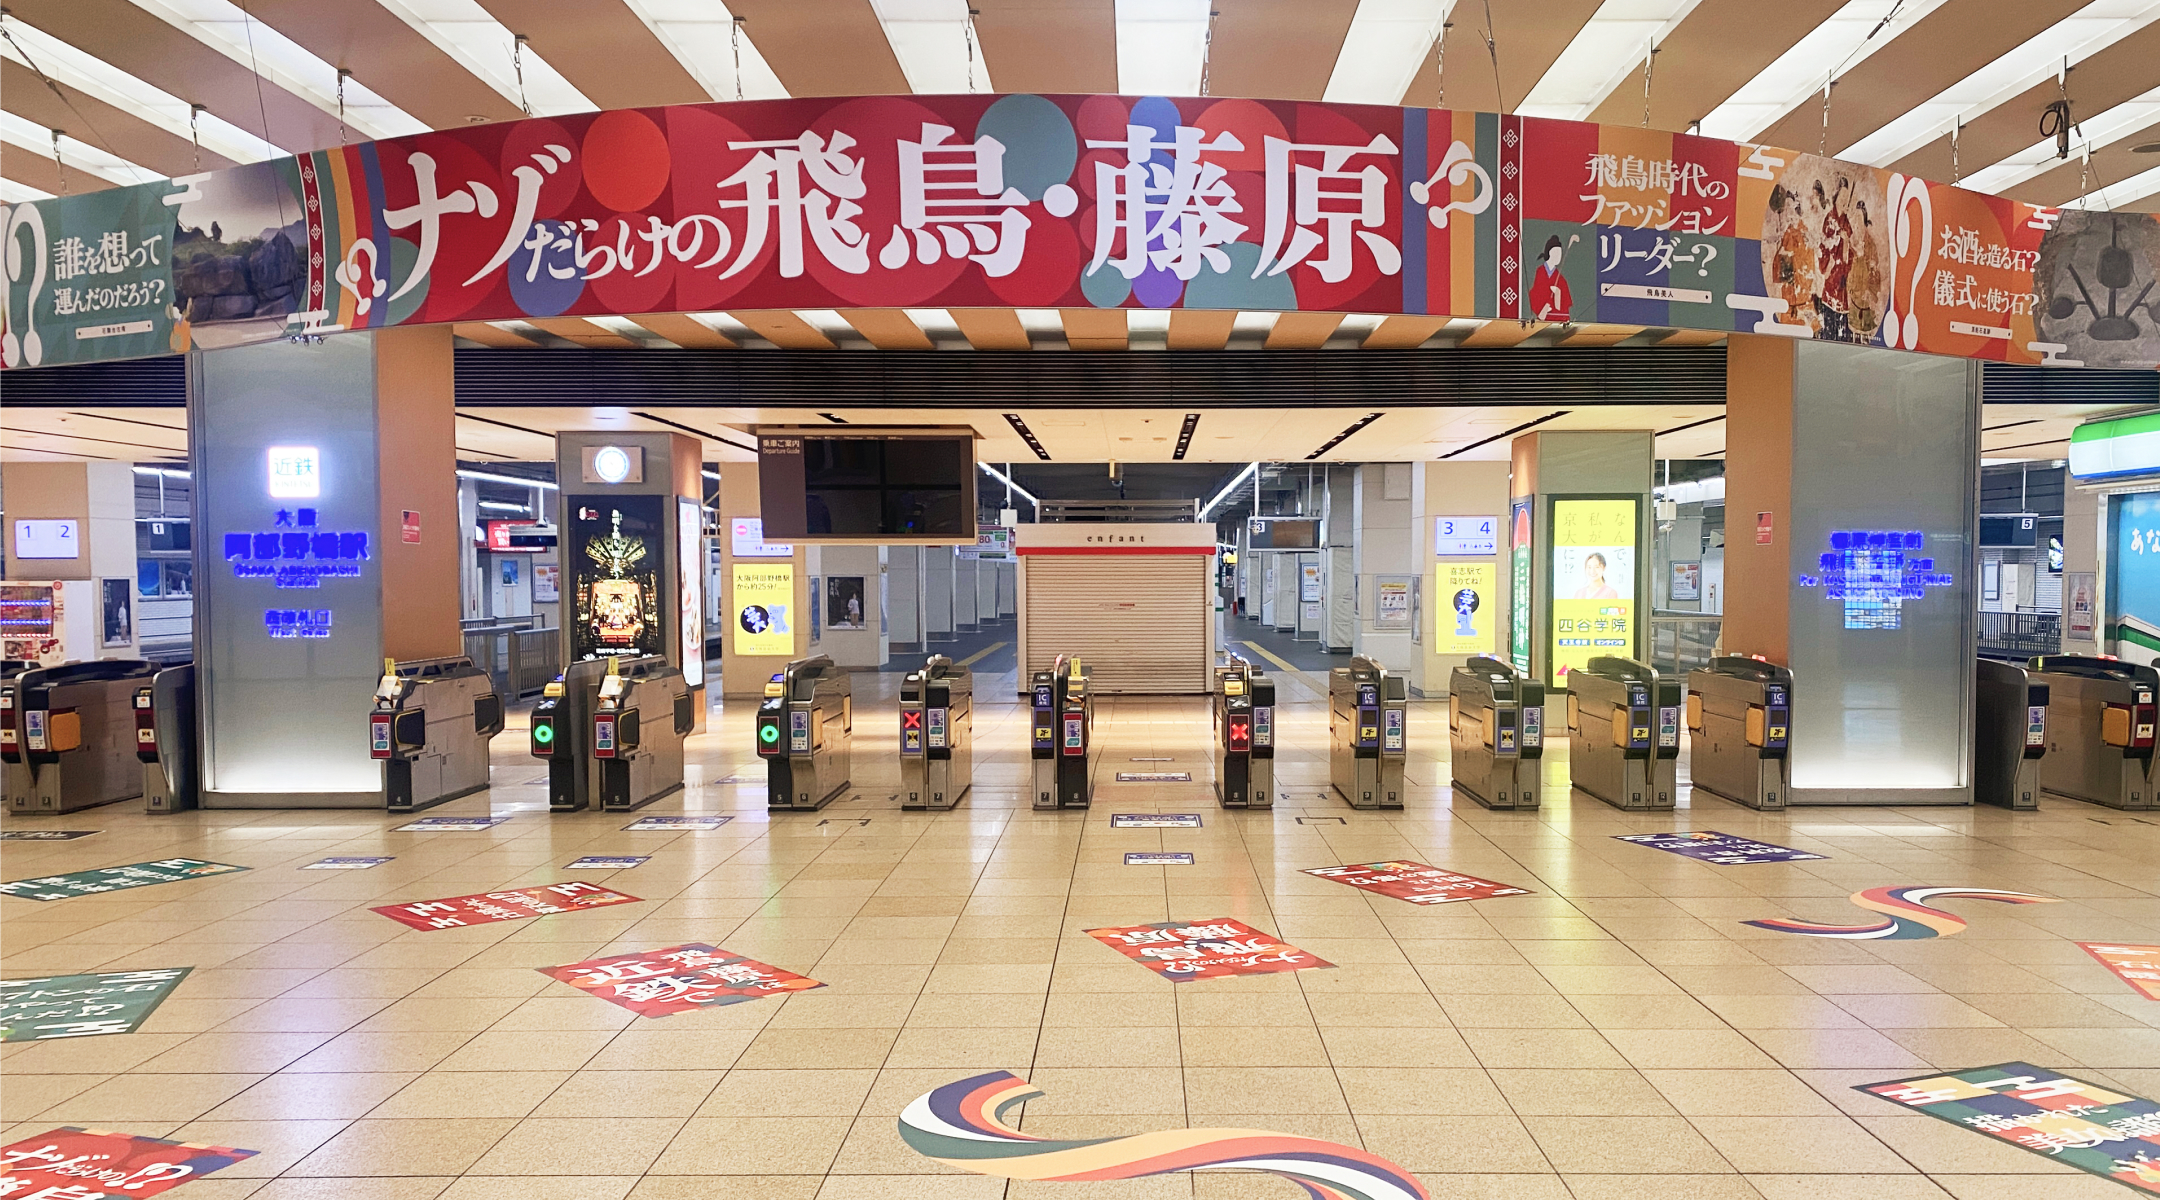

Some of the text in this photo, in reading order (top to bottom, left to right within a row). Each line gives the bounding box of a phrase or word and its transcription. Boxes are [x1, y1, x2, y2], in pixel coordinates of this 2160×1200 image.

[1583, 153, 1730, 200] 飛鳥時代の
[1578, 193, 1729, 236] ファッション
[53, 230, 163, 281] 誰を想って
[1600, 232, 1718, 276] リーダー?
[1937, 224, 2041, 273] お酒を造る石?
[53, 279, 165, 316] 運んだのだろう?
[1646, 288, 1674, 298] 飛鳥美人
[1932, 269, 2040, 316] 儀式に使う石?
[273, 456, 314, 476] 近鉄
[23, 525, 71, 538] 1 2
[155, 525, 162, 534] 1
[1086, 534, 1146, 543] enfant
[1444, 521, 1491, 535] 3 4
[2023, 519, 2031, 529] 5
[1558, 618, 1627, 633] 四谷学院
[567, 959, 723, 1003] 近鉄で
[1963, 1104, 2109, 1133] 描かれた
